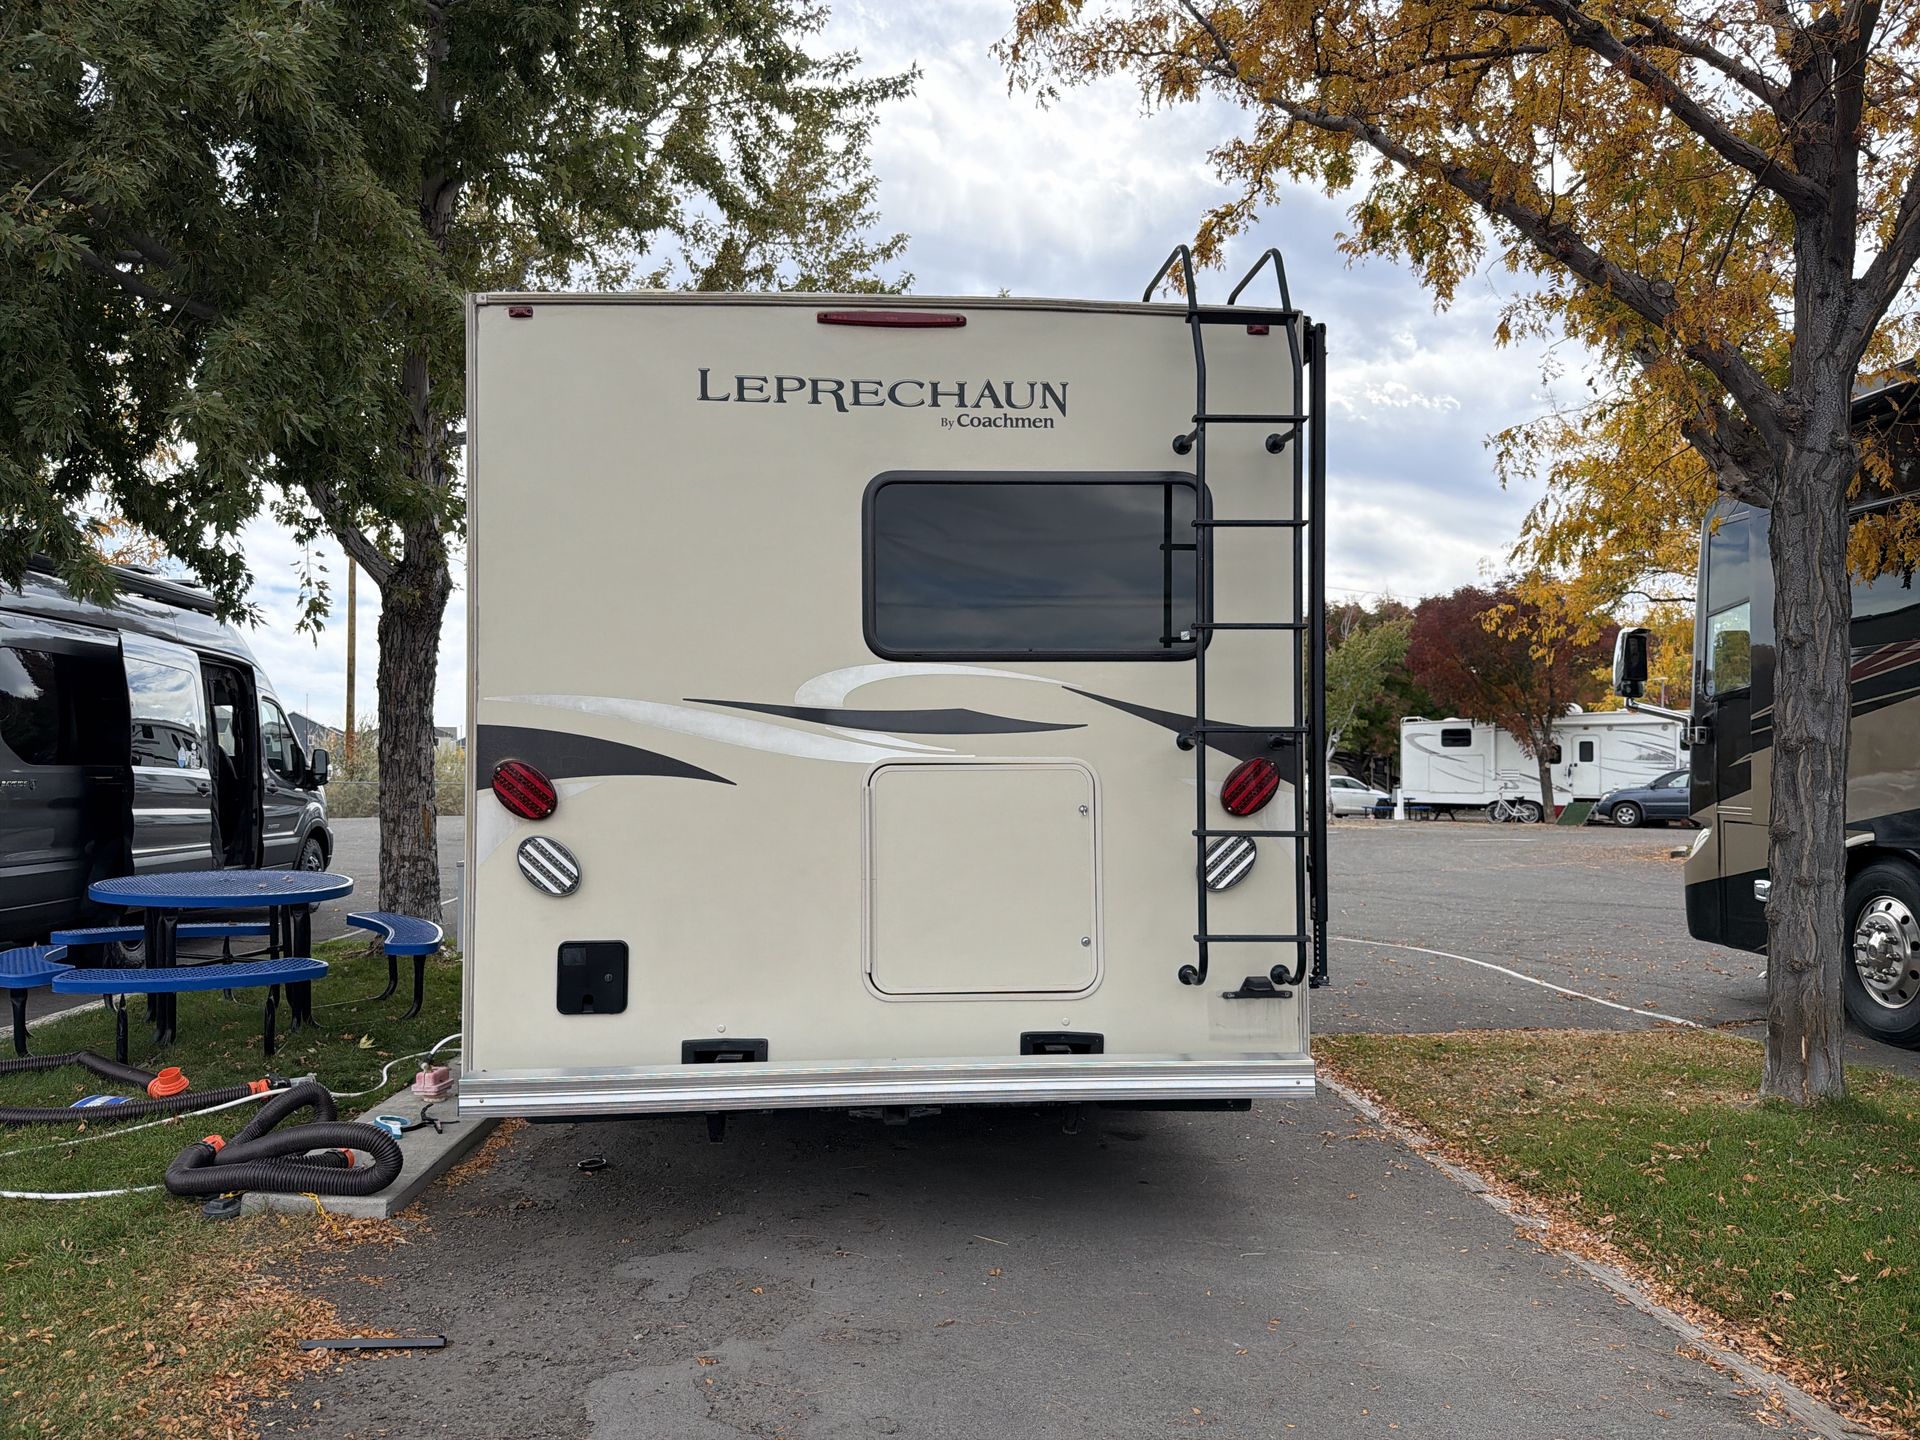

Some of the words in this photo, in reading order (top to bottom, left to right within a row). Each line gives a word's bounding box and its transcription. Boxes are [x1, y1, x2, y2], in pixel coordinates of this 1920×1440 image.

[697, 367, 1069, 417] LEPRECHAUN
[941, 416, 955, 430] By
[956, 413, 1055, 429] Coachmen
